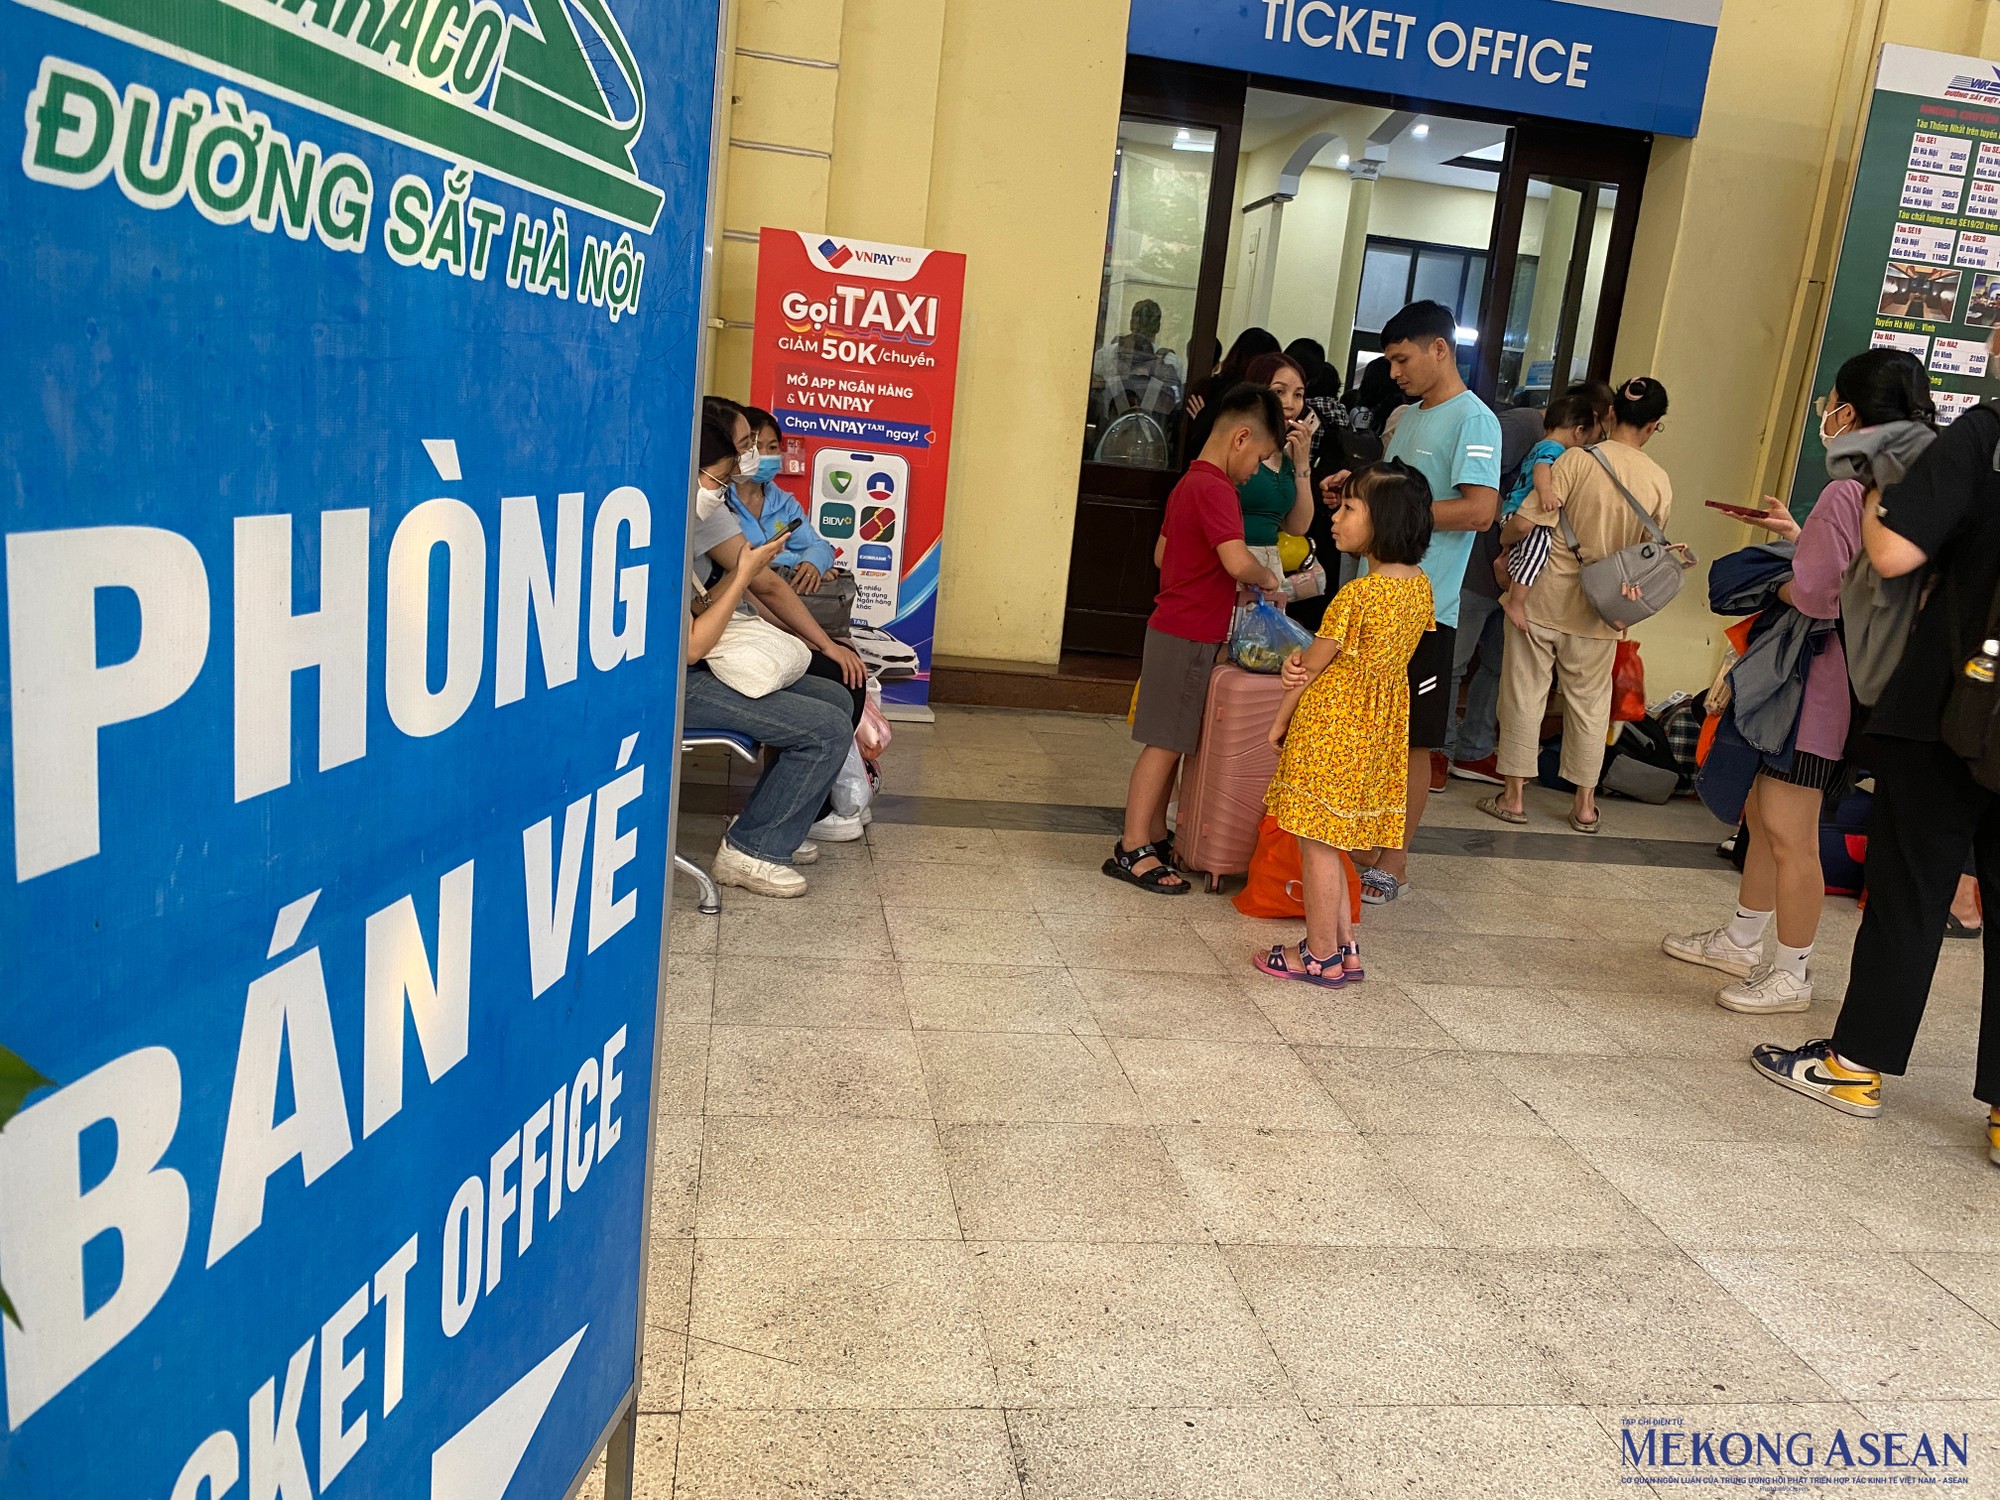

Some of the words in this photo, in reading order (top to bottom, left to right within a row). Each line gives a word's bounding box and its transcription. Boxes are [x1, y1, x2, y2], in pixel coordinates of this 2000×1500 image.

[1262, 0, 1416, 60] TICKET
[1427, 21, 1593, 89] OFFICE
[25, 57, 371, 250] ĐƯỜNG
[385, 165, 502, 280] SẮT
[507, 203, 568, 298] HÀ
[579, 234, 645, 322] NỘI
[782, 292, 838, 331] Gọi
[836, 285, 938, 336] TAXI
[778, 333, 818, 353] GIẢM
[821, 338, 879, 366] 50K
[877, 348, 935, 368] /chuyến
[786, 372, 809, 387] MỞ
[811, 377, 836, 390] APP
[838, 379, 875, 395] NGÂN
[877, 383, 913, 399] HÀNG
[787, 393, 795, 404] &
[817, 393, 874, 413] VNPAY
[785, 416, 817, 432] Chọn
[886, 428, 919, 442] ngay!
[822, 516, 844, 527] BIDV
[5, 438, 651, 883] PHÒNG
[0, 857, 474, 1432] BÁN
[522, 731, 645, 1000] VÉ
[441, 1023, 627, 1338] OFFICE
